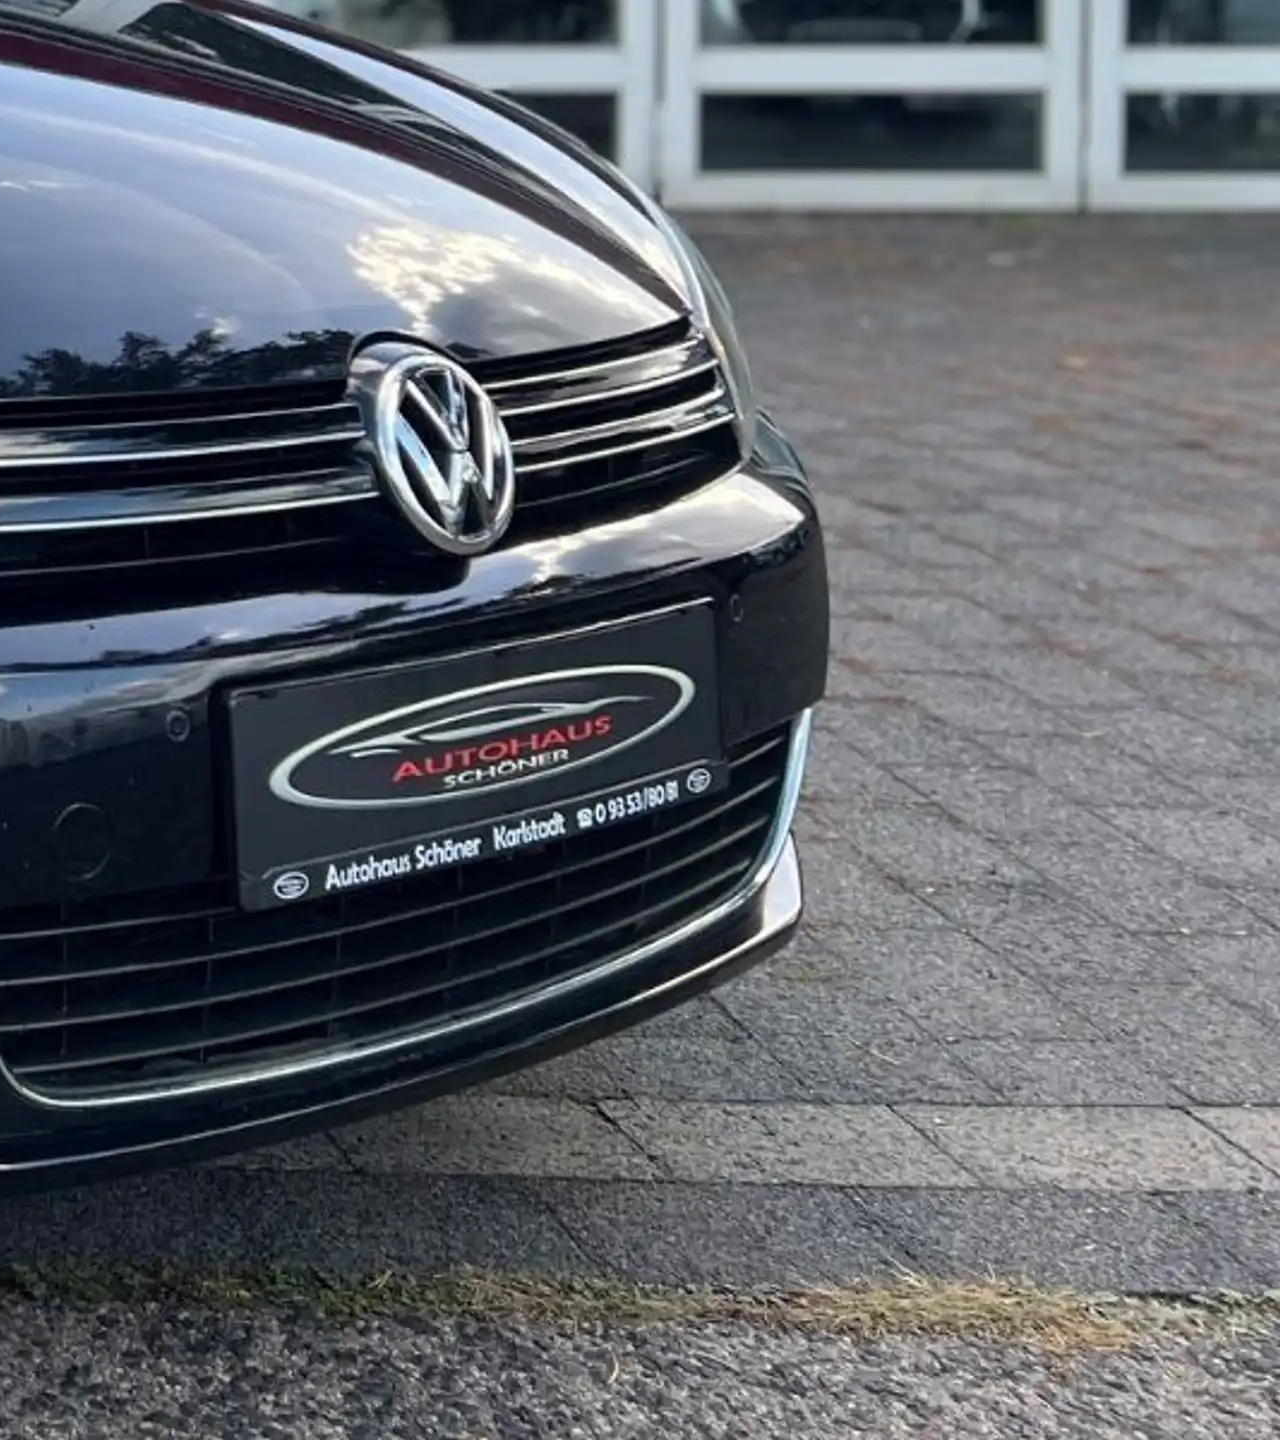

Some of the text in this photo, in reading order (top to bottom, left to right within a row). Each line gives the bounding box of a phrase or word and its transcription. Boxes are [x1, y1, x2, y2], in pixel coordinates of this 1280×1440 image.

[393, 714, 612, 782] AUTOHAUS
[443, 748, 569, 789] SCHÖNER
[324, 854, 411, 891] Autohaus
[415, 837, 481, 870] Schöner
[492, 811, 566, 851] Karlstadt
